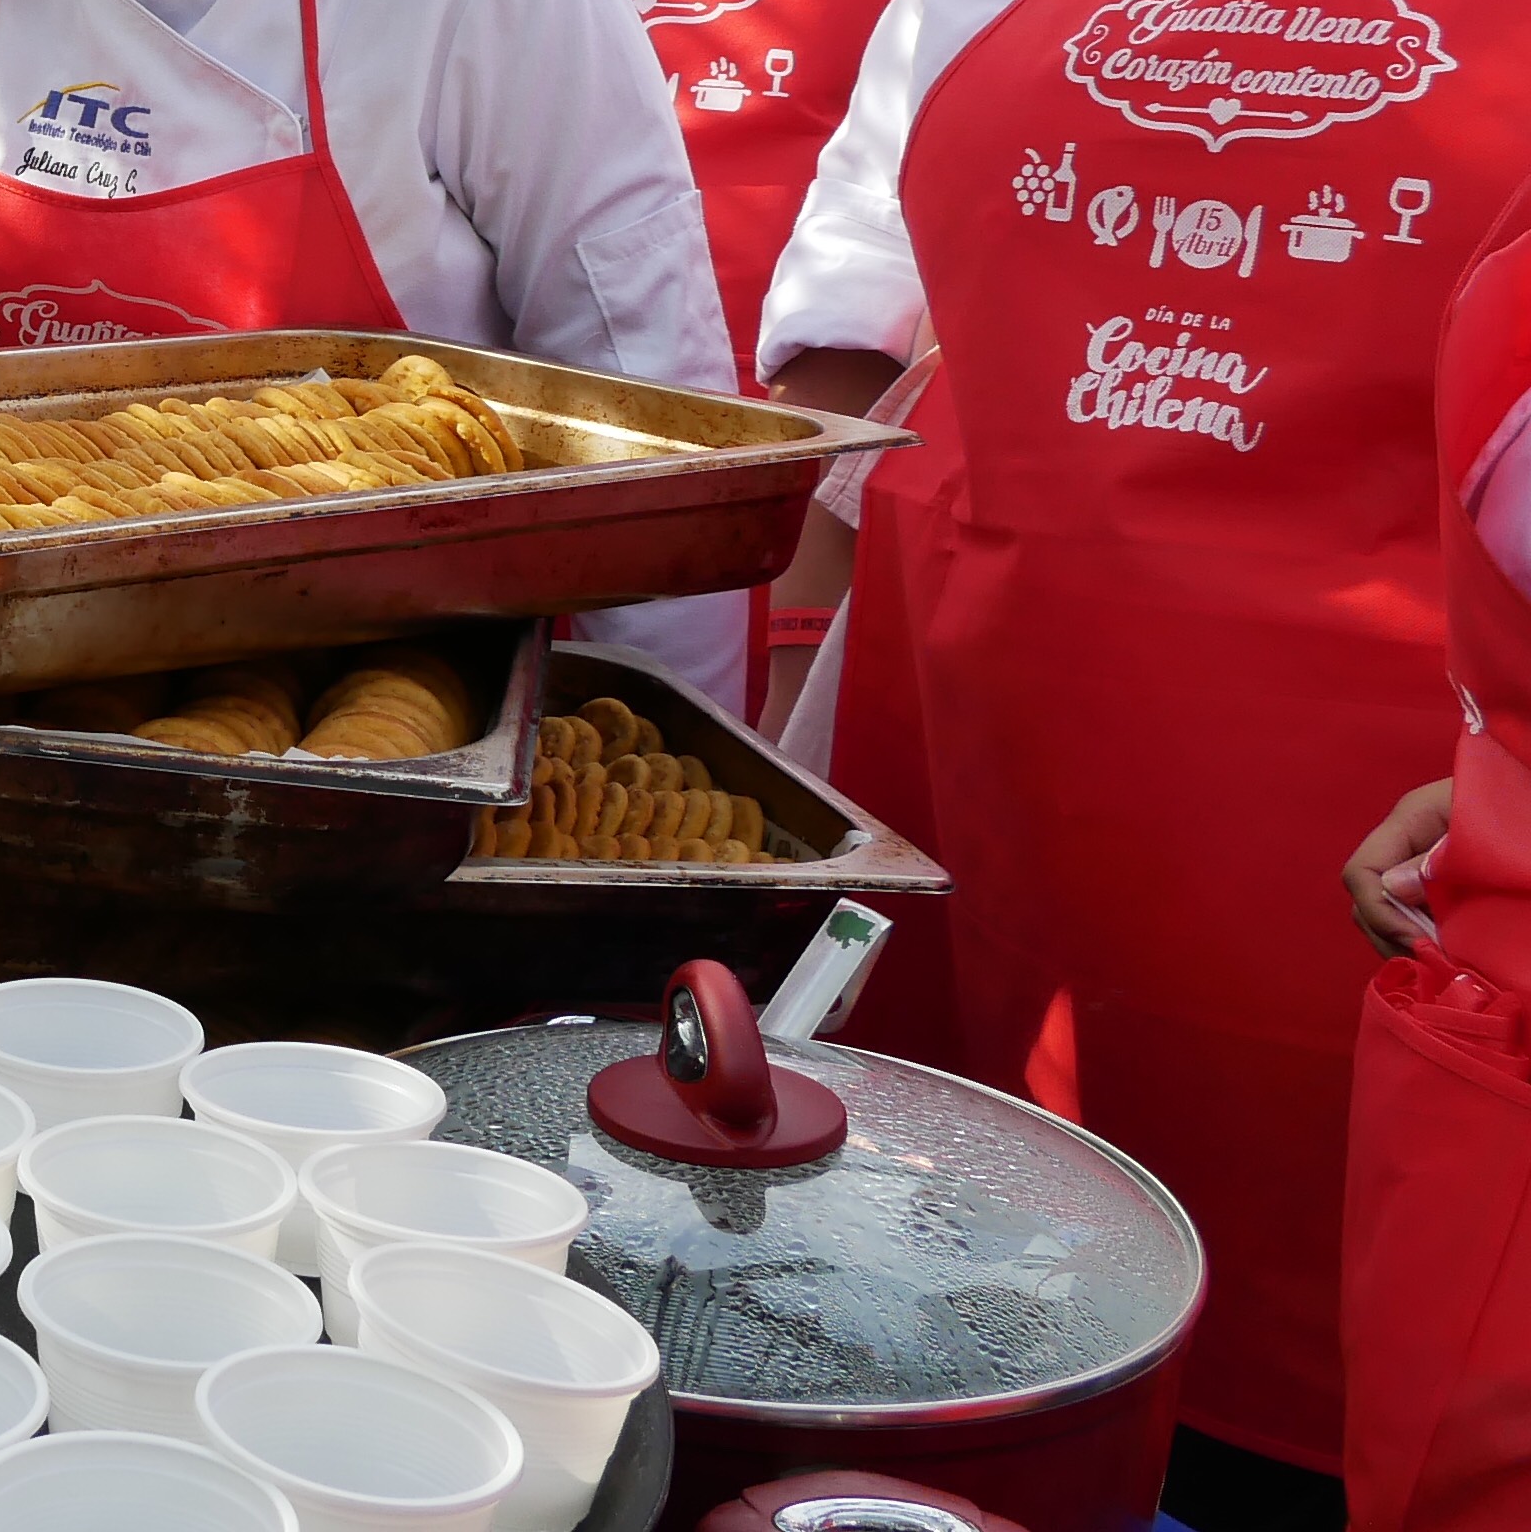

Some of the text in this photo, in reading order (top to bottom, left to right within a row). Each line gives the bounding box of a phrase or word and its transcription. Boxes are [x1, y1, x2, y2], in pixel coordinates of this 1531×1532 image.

[1283, 6, 1395, 46] llena
[1101, 48, 1383, 101] Corazón contento
[40, 90, 151, 139] ITC
[120, 139, 131, 153] de
[86, 162, 118, 198] Cruz
[1195, 207, 1224, 232] 15
[1175, 233, 1238, 258] Abril
[1145, 305, 1233, 331] DÍA DE LA
[1085, 315, 1269, 394] Cocina
[1066, 368, 1266, 453] Chilena
